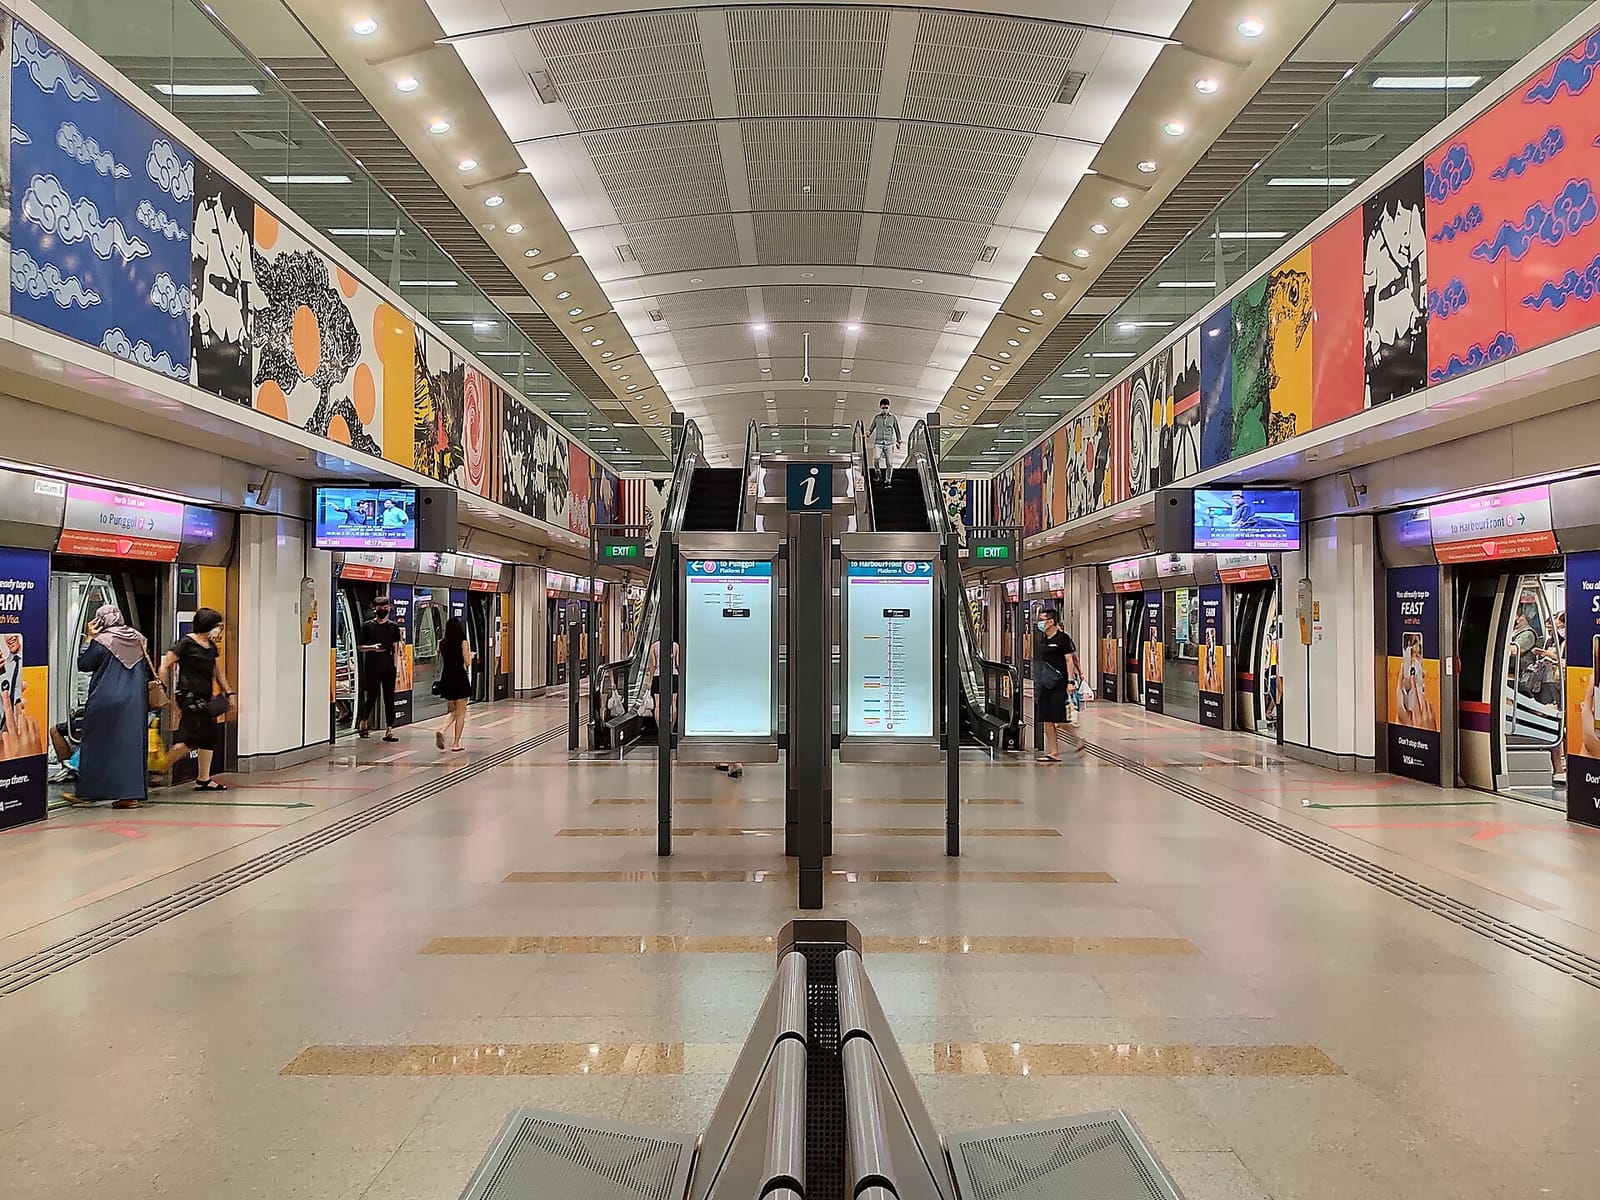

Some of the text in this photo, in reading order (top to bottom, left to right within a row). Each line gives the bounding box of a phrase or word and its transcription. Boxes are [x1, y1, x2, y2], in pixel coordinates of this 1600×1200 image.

[99, 513, 107, 524] to
[109, 513, 138, 530] Punggol
[1451, 524, 1458, 534] to
[1459, 517, 1505, 533] HarbourFront
[612, 546, 630, 556] EXIT
[983, 547, 1001, 557] EXIT
[0, 579, 35, 591] eady tap to
[1582, 580, 1595, 591] You
[0, 594, 24, 611] ARN
[1400, 601, 1425, 615] FEAST
[189, 749, 198, 759] VIS
[1402, 754, 1415, 765] VISA
